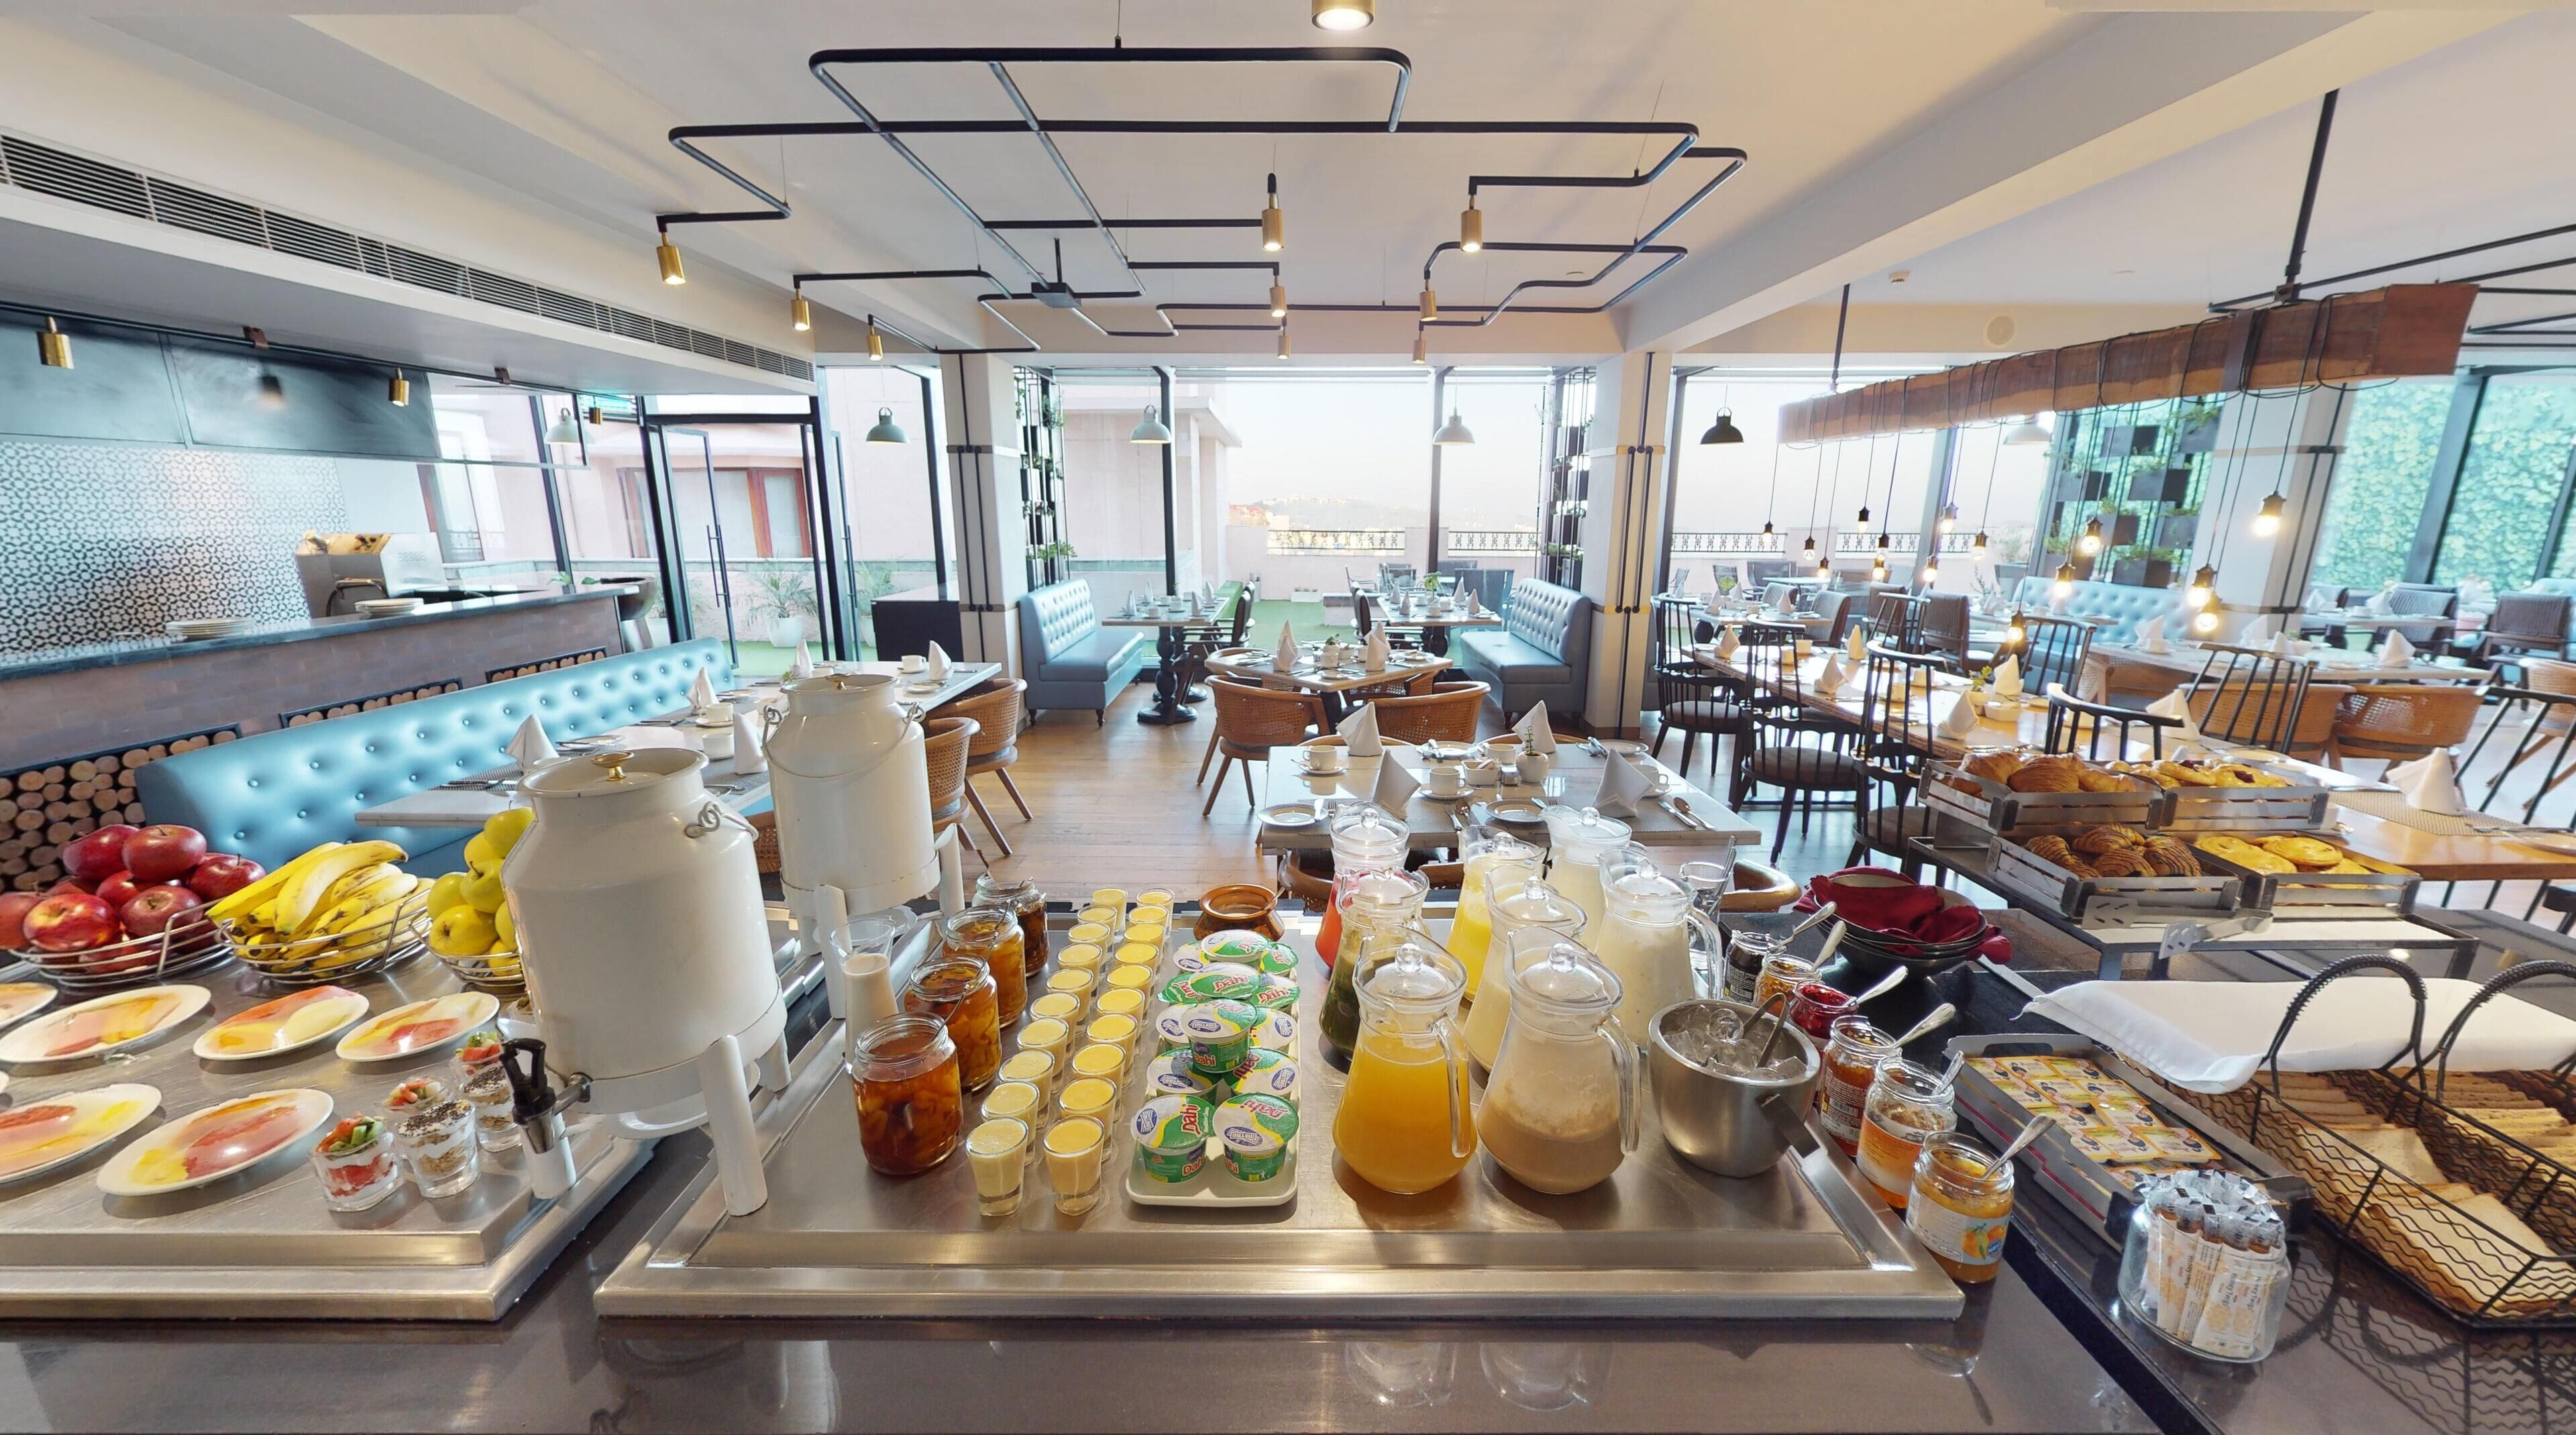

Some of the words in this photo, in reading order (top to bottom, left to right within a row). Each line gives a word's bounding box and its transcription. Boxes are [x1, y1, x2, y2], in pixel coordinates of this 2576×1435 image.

[1214, 975, 1250, 994] Dahi
[1258, 987, 1289, 1004] Dahi
[1193, 1051, 1217, 1067] Dahi
[1239, 1100, 1291, 1120] Dahi
[1180, 1103, 1202, 1137] Dahi
